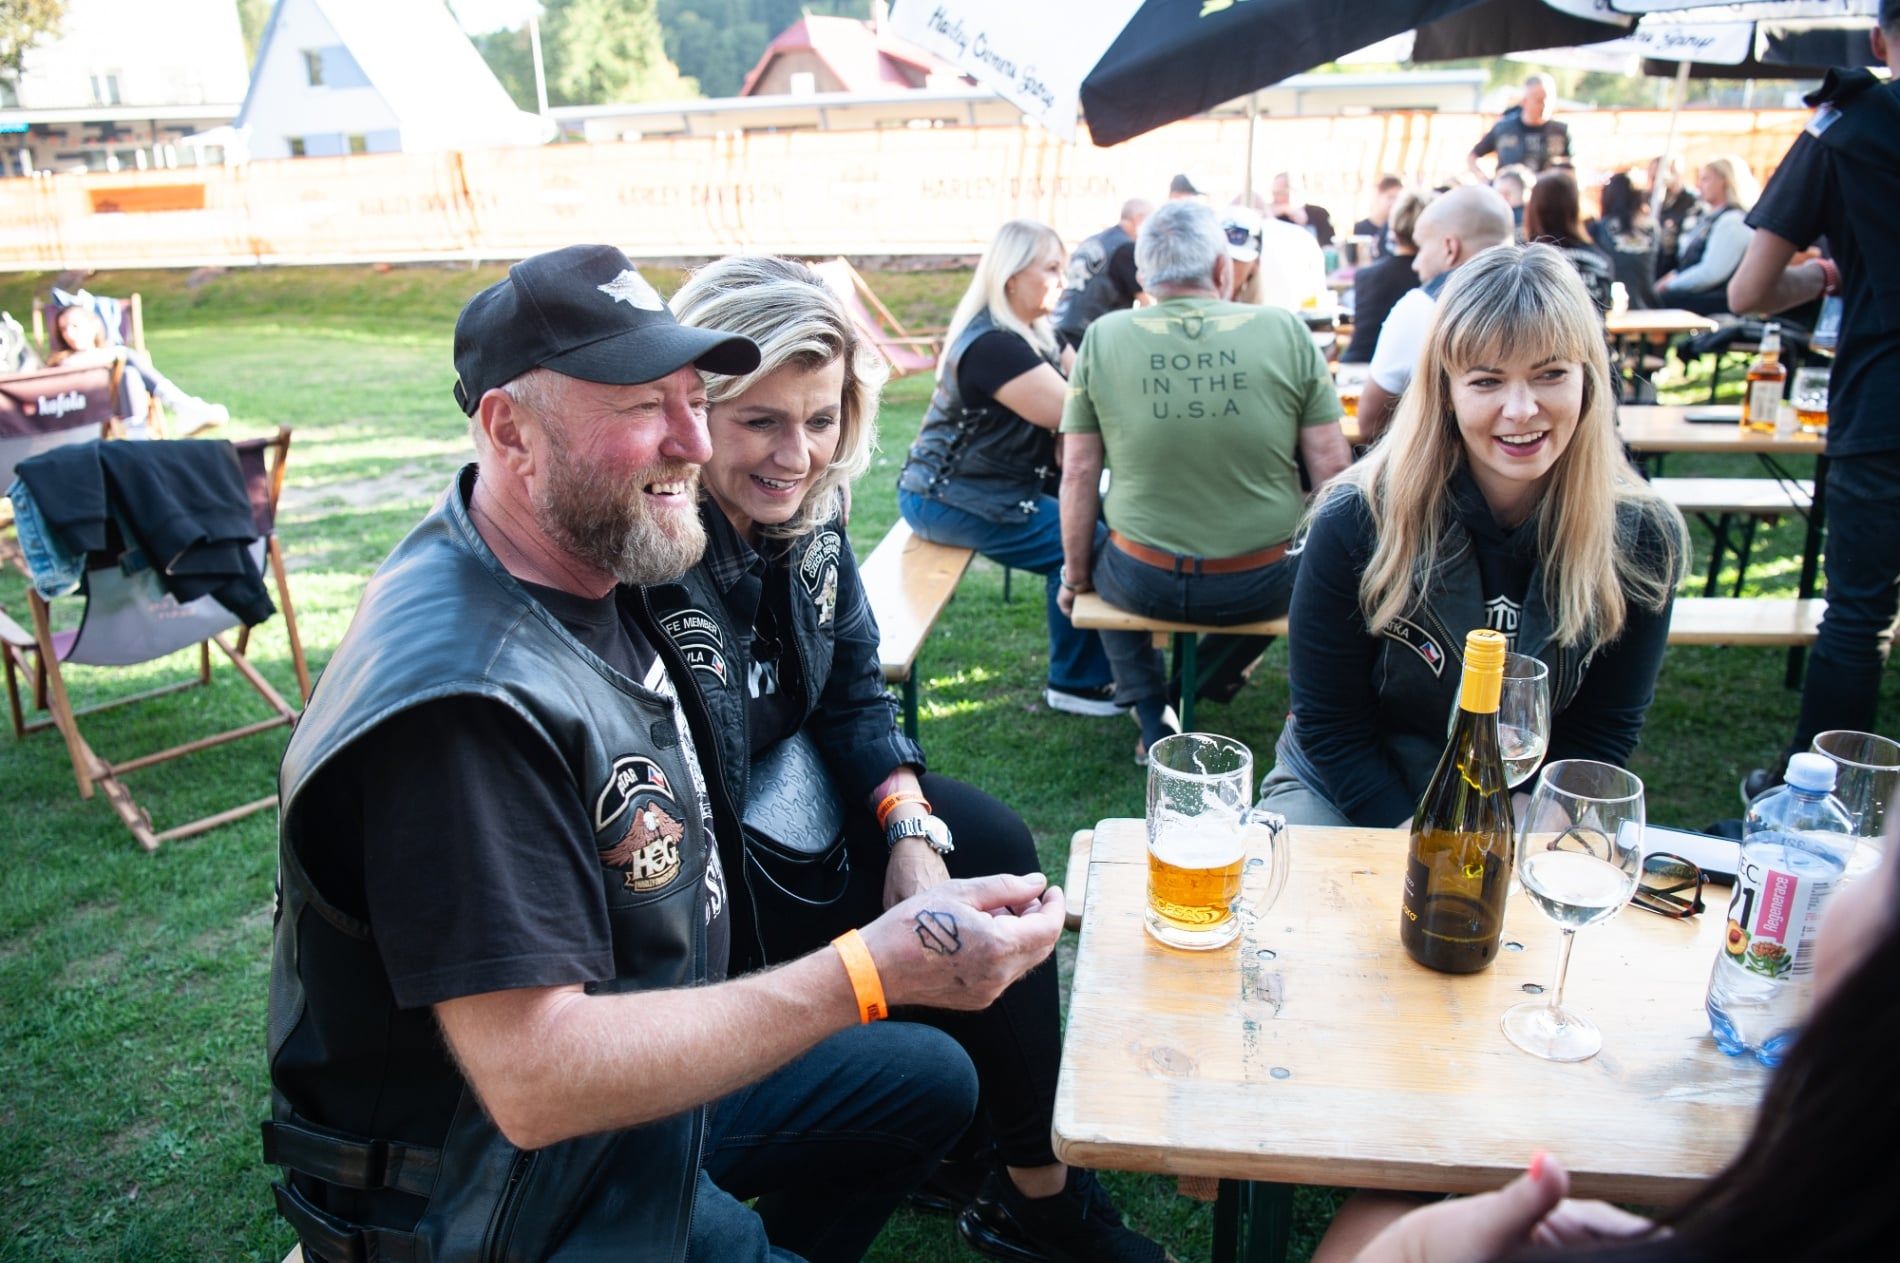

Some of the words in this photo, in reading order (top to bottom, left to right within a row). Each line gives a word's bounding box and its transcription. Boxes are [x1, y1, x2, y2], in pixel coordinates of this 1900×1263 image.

[1150, 349, 1236, 371] BORN
[1142, 377, 1170, 395] IN
[1187, 372, 1248, 394] THE
[1152, 398, 1240, 420] U.S.A
[665, 620, 681, 632] FE
[683, 616, 718, 636] MEMBER
[1762, 875, 1789, 933] Regenerace
